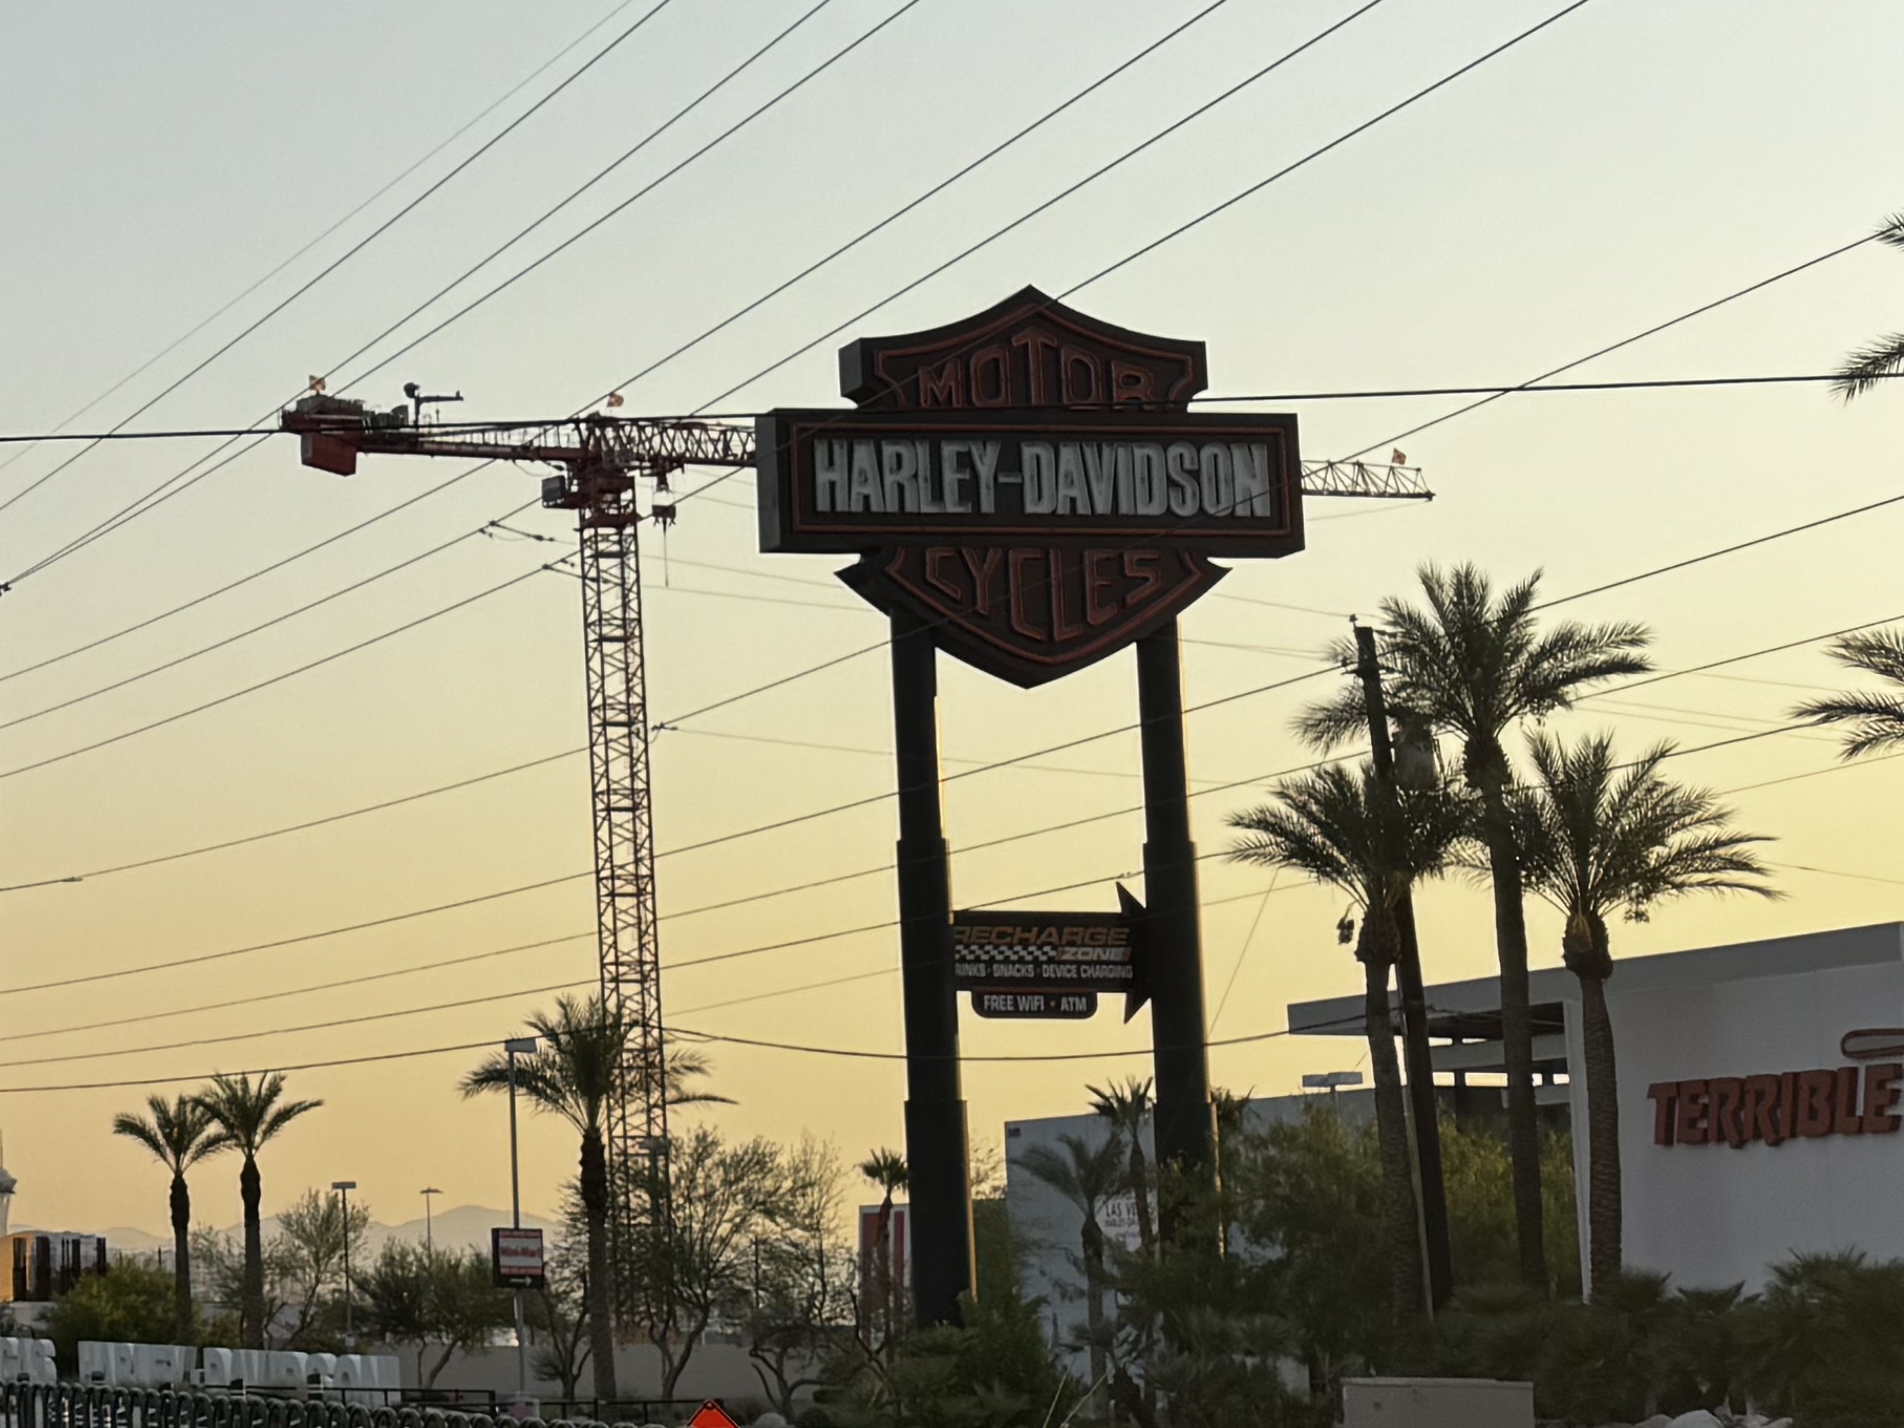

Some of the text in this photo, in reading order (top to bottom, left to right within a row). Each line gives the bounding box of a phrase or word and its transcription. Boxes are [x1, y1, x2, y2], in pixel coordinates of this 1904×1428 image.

[917, 326, 1159, 412] MOTOR
[812, 437, 1272, 518] HARLEY-DAVIDSON
[924, 546, 1162, 642] CYCLES
[954, 926, 1130, 945] RECHARGE
[1061, 947, 1127, 961] ZONE
[954, 963, 987, 978] RINKS
[983, 995, 1015, 1011] FREE
[1060, 996, 1087, 1012] ATM
[1646, 1063, 1904, 1149] TERRIBLE
